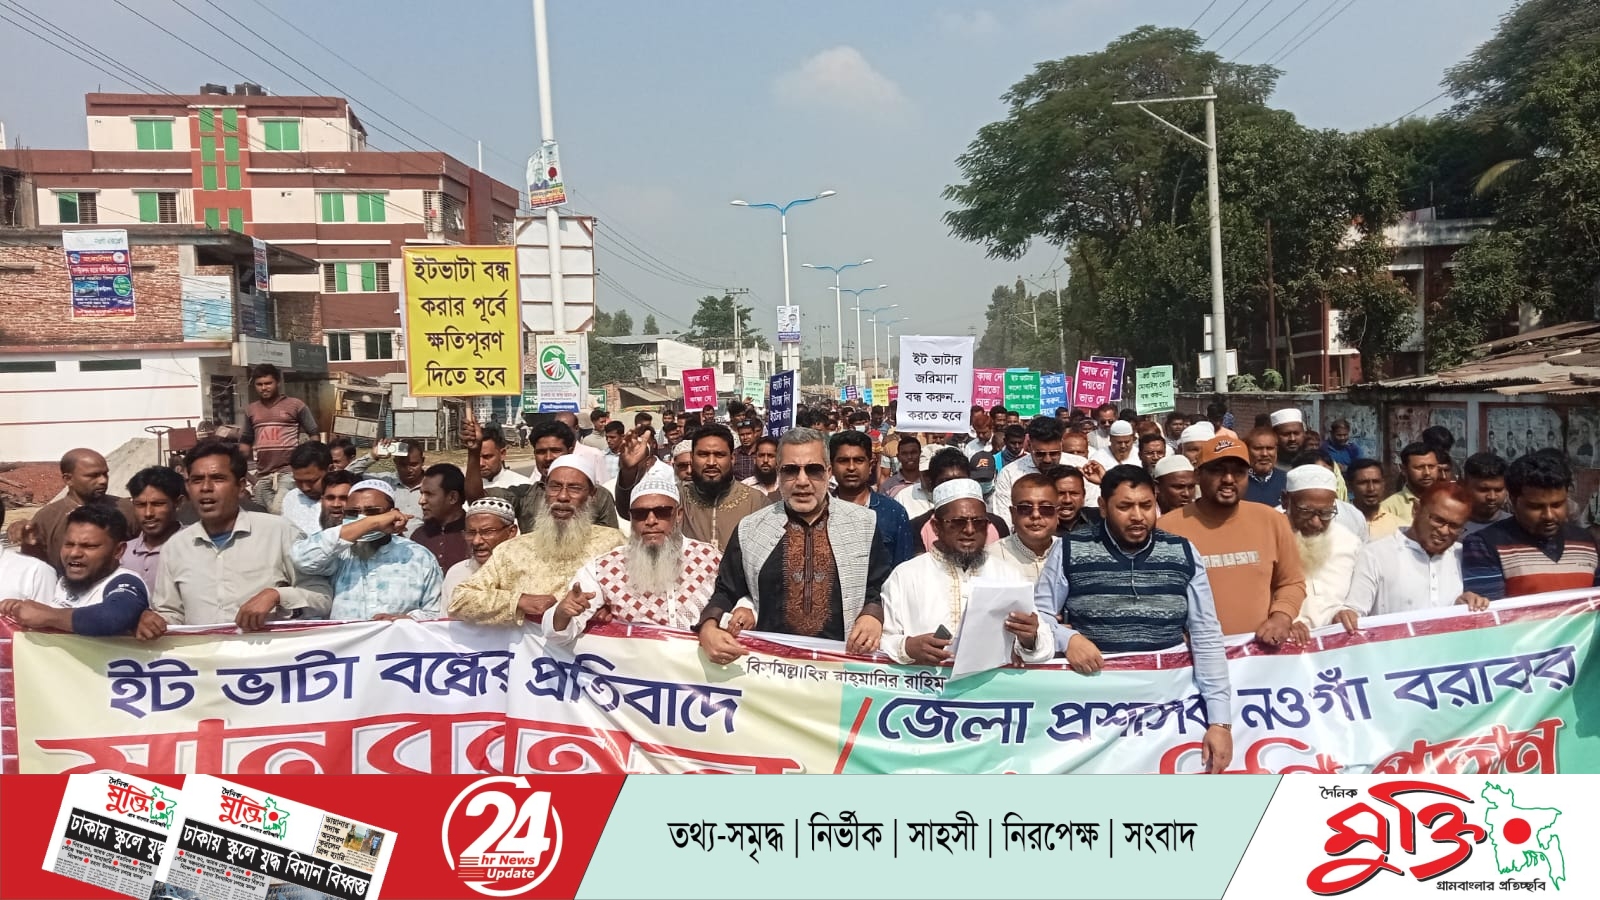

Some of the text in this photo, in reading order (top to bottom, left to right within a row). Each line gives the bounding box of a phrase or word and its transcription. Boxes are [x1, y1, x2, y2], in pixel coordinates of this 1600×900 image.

[412, 254, 511, 283] ইটভাটা বন্ধ
[418, 290, 509, 324] করার পূর্বে
[425, 325, 504, 358] ক্ষতিপূরণ
[912, 352, 962, 366] ইট ভাটার
[425, 361, 507, 390] দিতে হবে
[914, 371, 958, 384] জরিমানা
[1081, 366, 1110, 377] কাজ দে
[1082, 380, 1105, 391] নয়তো
[904, 392, 922, 402] বন্ধ
[906, 410, 963, 422] করতে হবে
[108, 660, 198, 718] ইট
[216, 650, 360, 706] ভাটা
[526, 653, 742, 733] প্রতিবাদে
[878, 698, 1034, 744] জেলা
[1237, 666, 1372, 730] নওগাঁ
[1384, 646, 1576, 710] বরাবর
